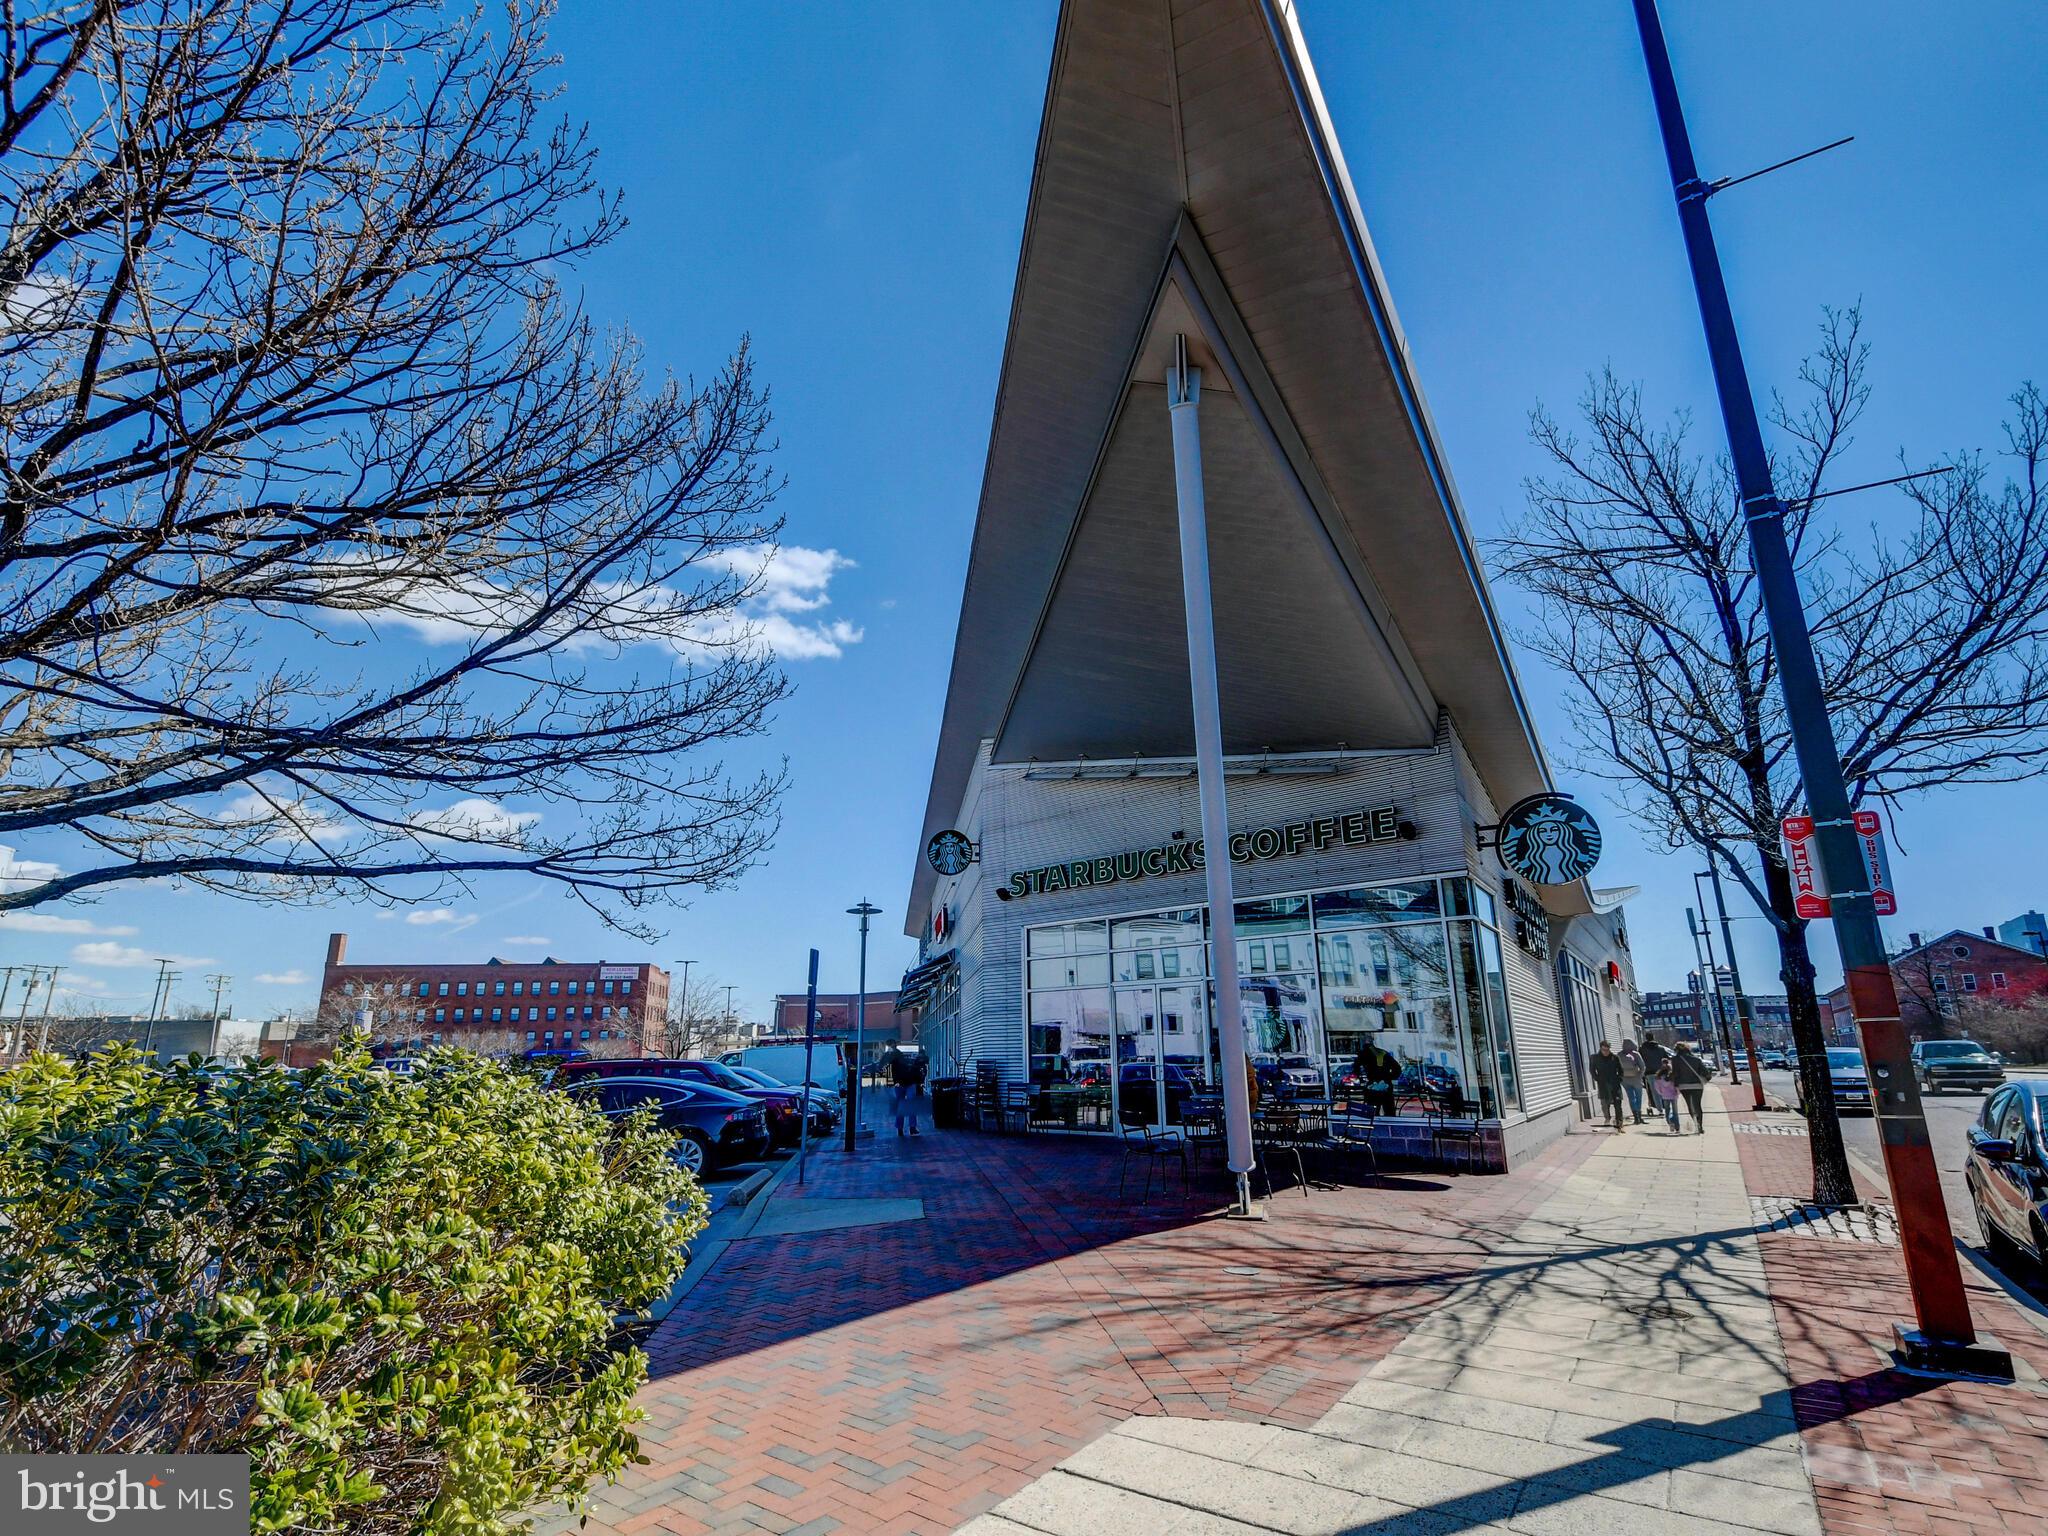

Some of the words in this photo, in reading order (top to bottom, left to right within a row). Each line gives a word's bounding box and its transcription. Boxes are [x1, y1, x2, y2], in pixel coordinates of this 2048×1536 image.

[1010, 838, 1208, 897] STARBUCKS
[1228, 805, 1397, 863] COFFEE
[1866, 839, 1877, 858] BUS
[1870, 861, 1882, 887] STOP
